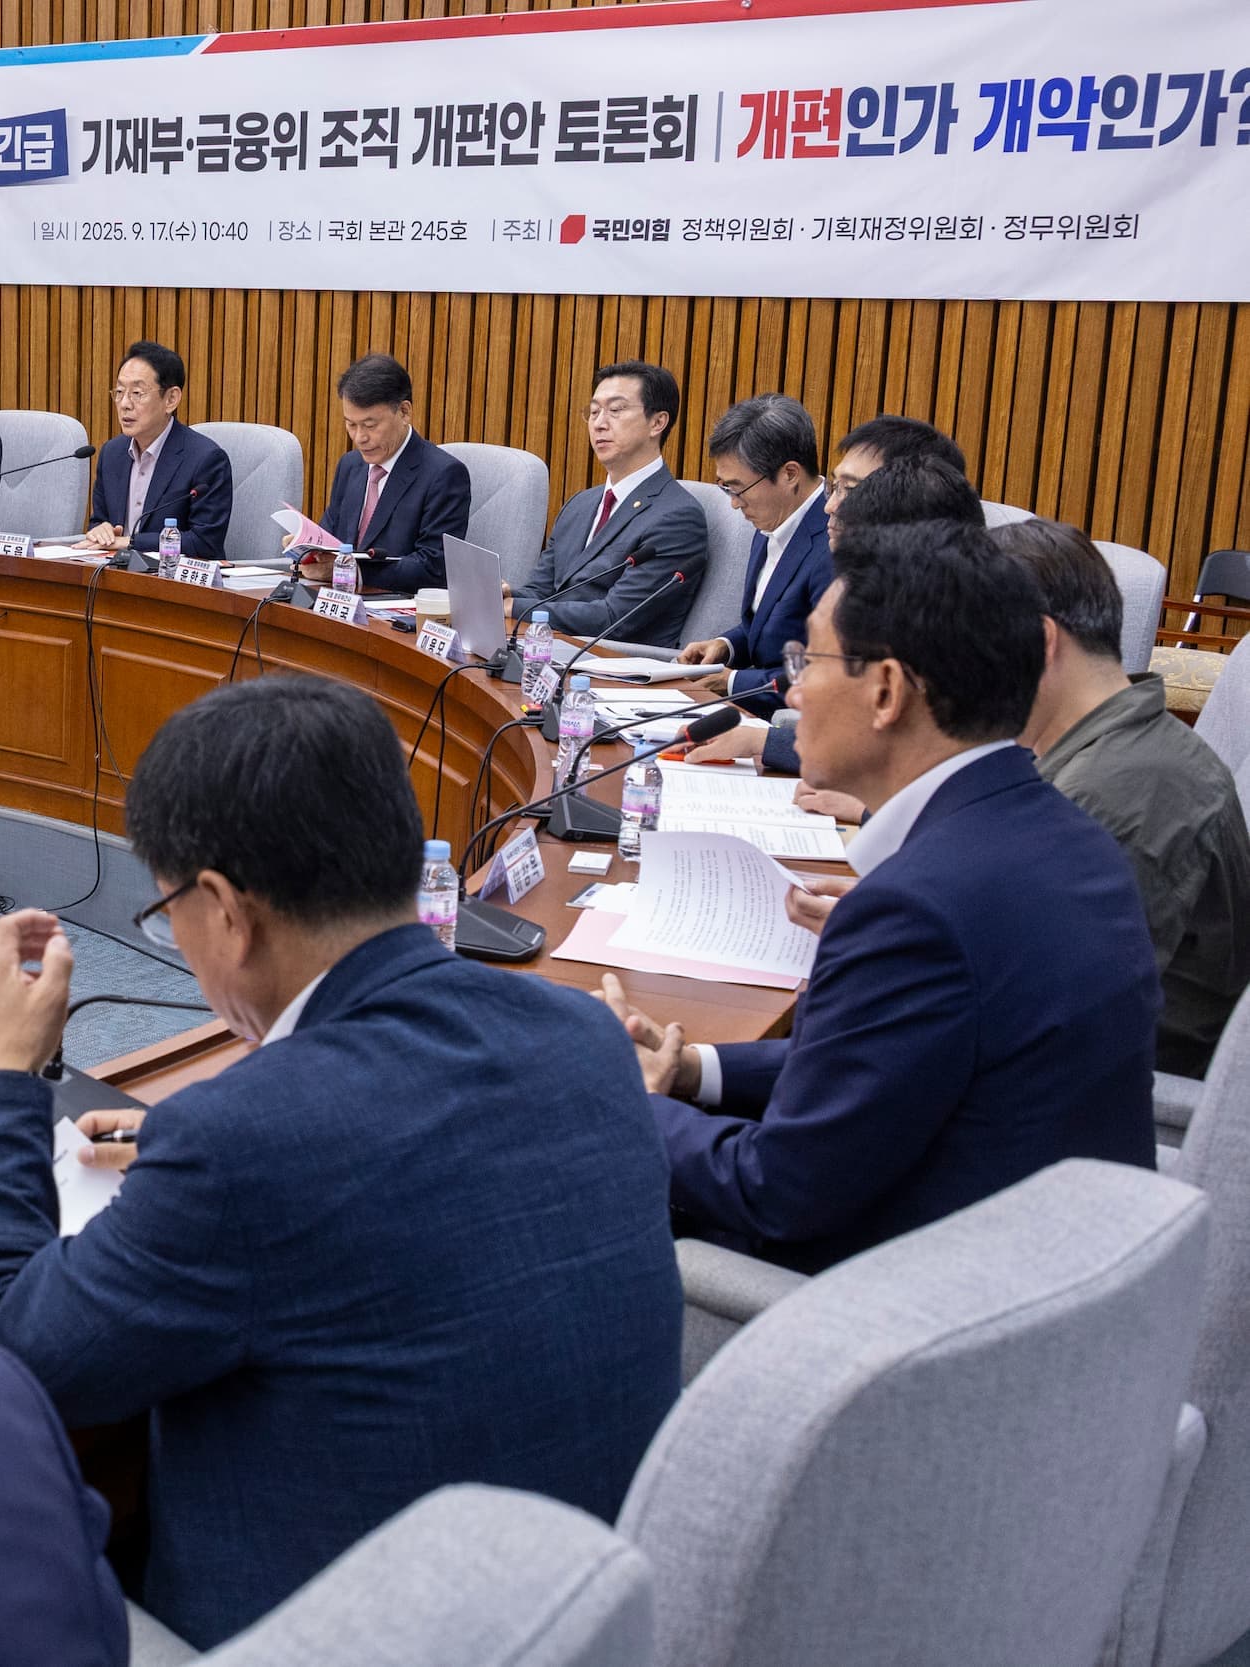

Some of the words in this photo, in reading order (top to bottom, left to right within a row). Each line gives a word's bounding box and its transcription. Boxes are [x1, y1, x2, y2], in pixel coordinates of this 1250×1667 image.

[81, 111, 308, 175] 기재부·금융위
[319, 106, 399, 169] 조직
[411, 100, 546, 168] 개편안
[554, 94, 699, 163] 토론회
[737, 82, 959, 160] 개편인가
[973, 67, 1250, 153] 개악인가?
[40, 220, 69, 241] 일시
[82, 221, 127, 241] 2025.
[132, 222, 145, 241] 9.
[202, 221, 249, 241] 10:40
[278, 220, 312, 241] 장소
[328, 219, 363, 241] 국회
[369, 220, 406, 241] 본관
[411, 219, 468, 241] 245호
[502, 218, 541, 241] 주최
[592, 218, 671, 242] 국민의힘
[682, 217, 794, 241] 정책위원회
[811, 216, 984, 241] 기획재정위원회
[1003, 213, 1140, 241] 정무위원회
